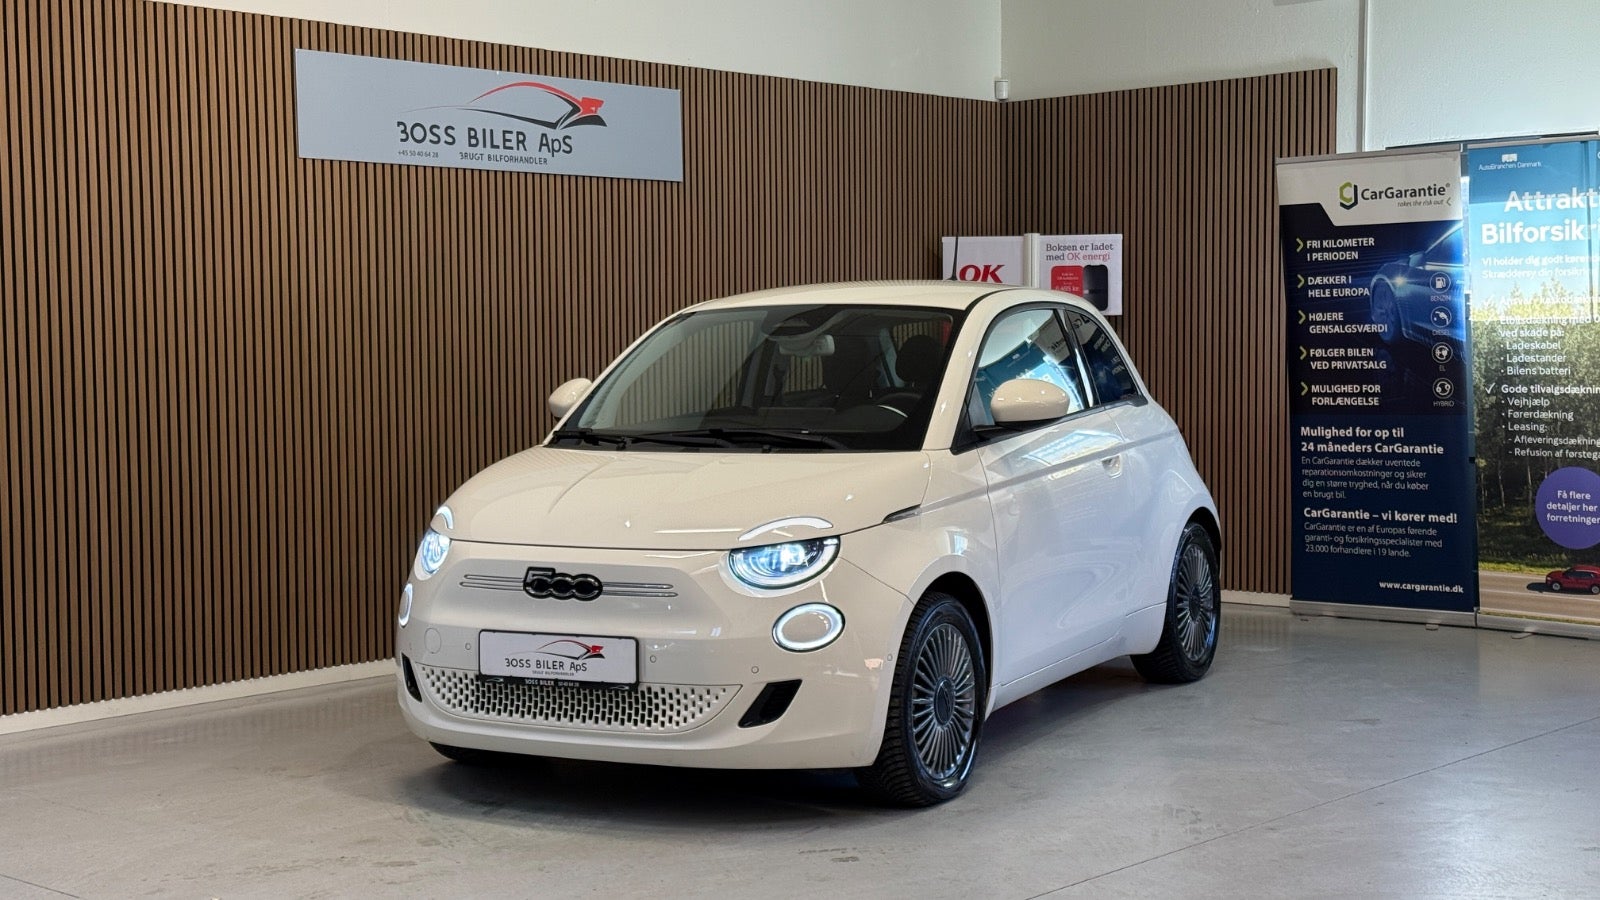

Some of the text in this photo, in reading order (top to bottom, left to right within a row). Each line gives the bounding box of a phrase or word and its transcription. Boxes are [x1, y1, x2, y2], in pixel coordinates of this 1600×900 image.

[467, 127, 527, 151] BILER
[538, 132, 573, 158] ApS
[487, 153, 548, 165] BILFORHANDLER
[1504, 187, 1600, 212] Attrakt
[1481, 218, 1600, 245] Bilforsikr
[1046, 243, 1078, 252] Boksen
[1091, 242, 1114, 251] ladet
[1306, 237, 1375, 249] FRI KILOMETER
[1046, 252, 1110, 262] med OK energi
[1307, 251, 1358, 261] I PERIODEN
[1525, 255, 1540, 266] dig
[1542, 254, 1564, 266] godt
[959, 264, 1005, 284] OK
[1308, 276, 1352, 286] DÆKKER I
[1308, 288, 1370, 298] HELE EUROPA
[1309, 312, 1344, 321] HØJERE
[1309, 324, 1388, 334] GENSALGSVÆRDI
[1500, 328, 1518, 337] ved
[1520, 328, 1548, 337] skade
[1506, 341, 1561, 350] Ladeskabel
[1310, 348, 1374, 358] FØLGER BILEN
[1506, 354, 1566, 363] Ladestander
[1310, 360, 1386, 370] VED PRIVATSALG
[1506, 366, 1570, 376] Bilens batteri
[1312, 384, 1381, 394] MULIGHED FOR
[1501, 384, 1528, 394] Gode
[1312, 397, 1380, 406] FORLÆNGELSE
[1507, 396, 1550, 408] Vejhjælp
[1508, 409, 1574, 422] Førerdækning
[1300, 426, 1404, 440] Mulighed for op til
[1508, 422, 1548, 434] Leasing:
[1301, 442, 1444, 454] 24 måneders CarGarantie
[1514, 448, 1552, 458] Refusion
[1554, 448, 1563, 458] af
[1312, 457, 1354, 466] CarGarantie
[1356, 458, 1383, 466] dækker
[1384, 459, 1420, 468] uventede
[1302, 468, 1392, 479] reparationsomkostninger
[1406, 470, 1426, 478] sikrer
[1302, 480, 1314, 488] dig
[1326, 480, 1348, 488] større
[1349, 480, 1380, 490] tryghed,
[1381, 481, 1393, 489] når
[1394, 482, 1406, 490] du
[1406, 482, 1429, 490] køber
[1314, 490, 1334, 500] brugt
[1336, 490, 1346, 498] bil.
[1558, 490, 1591, 500] Få flere
[1546, 502, 1598, 512] detaljer her
[1304, 507, 1370, 520] CarGarantie
[1382, 510, 1392, 520] vi
[1394, 511, 1426, 522] kører
[1428, 512, 1458, 524] med!
[1304, 522, 1346, 532] CarGarantie
[1376, 525, 1406, 536] Europas
[1408, 526, 1438, 536] førende
[1304, 534, 1442, 548] garanti- og forsikringsspecialister med
[1306, 544, 1328, 552] 23.000
[1330, 545, 1372, 555] forhandlere
[1378, 548, 1387, 556] 19
[1388, 548, 1412, 558] lande.
[523, 566, 603, 601] 500
[1379, 581, 1464, 594] www.cargarantie.dk
[536, 659, 564, 671] BILER
[570, 661, 588, 674] ApS
